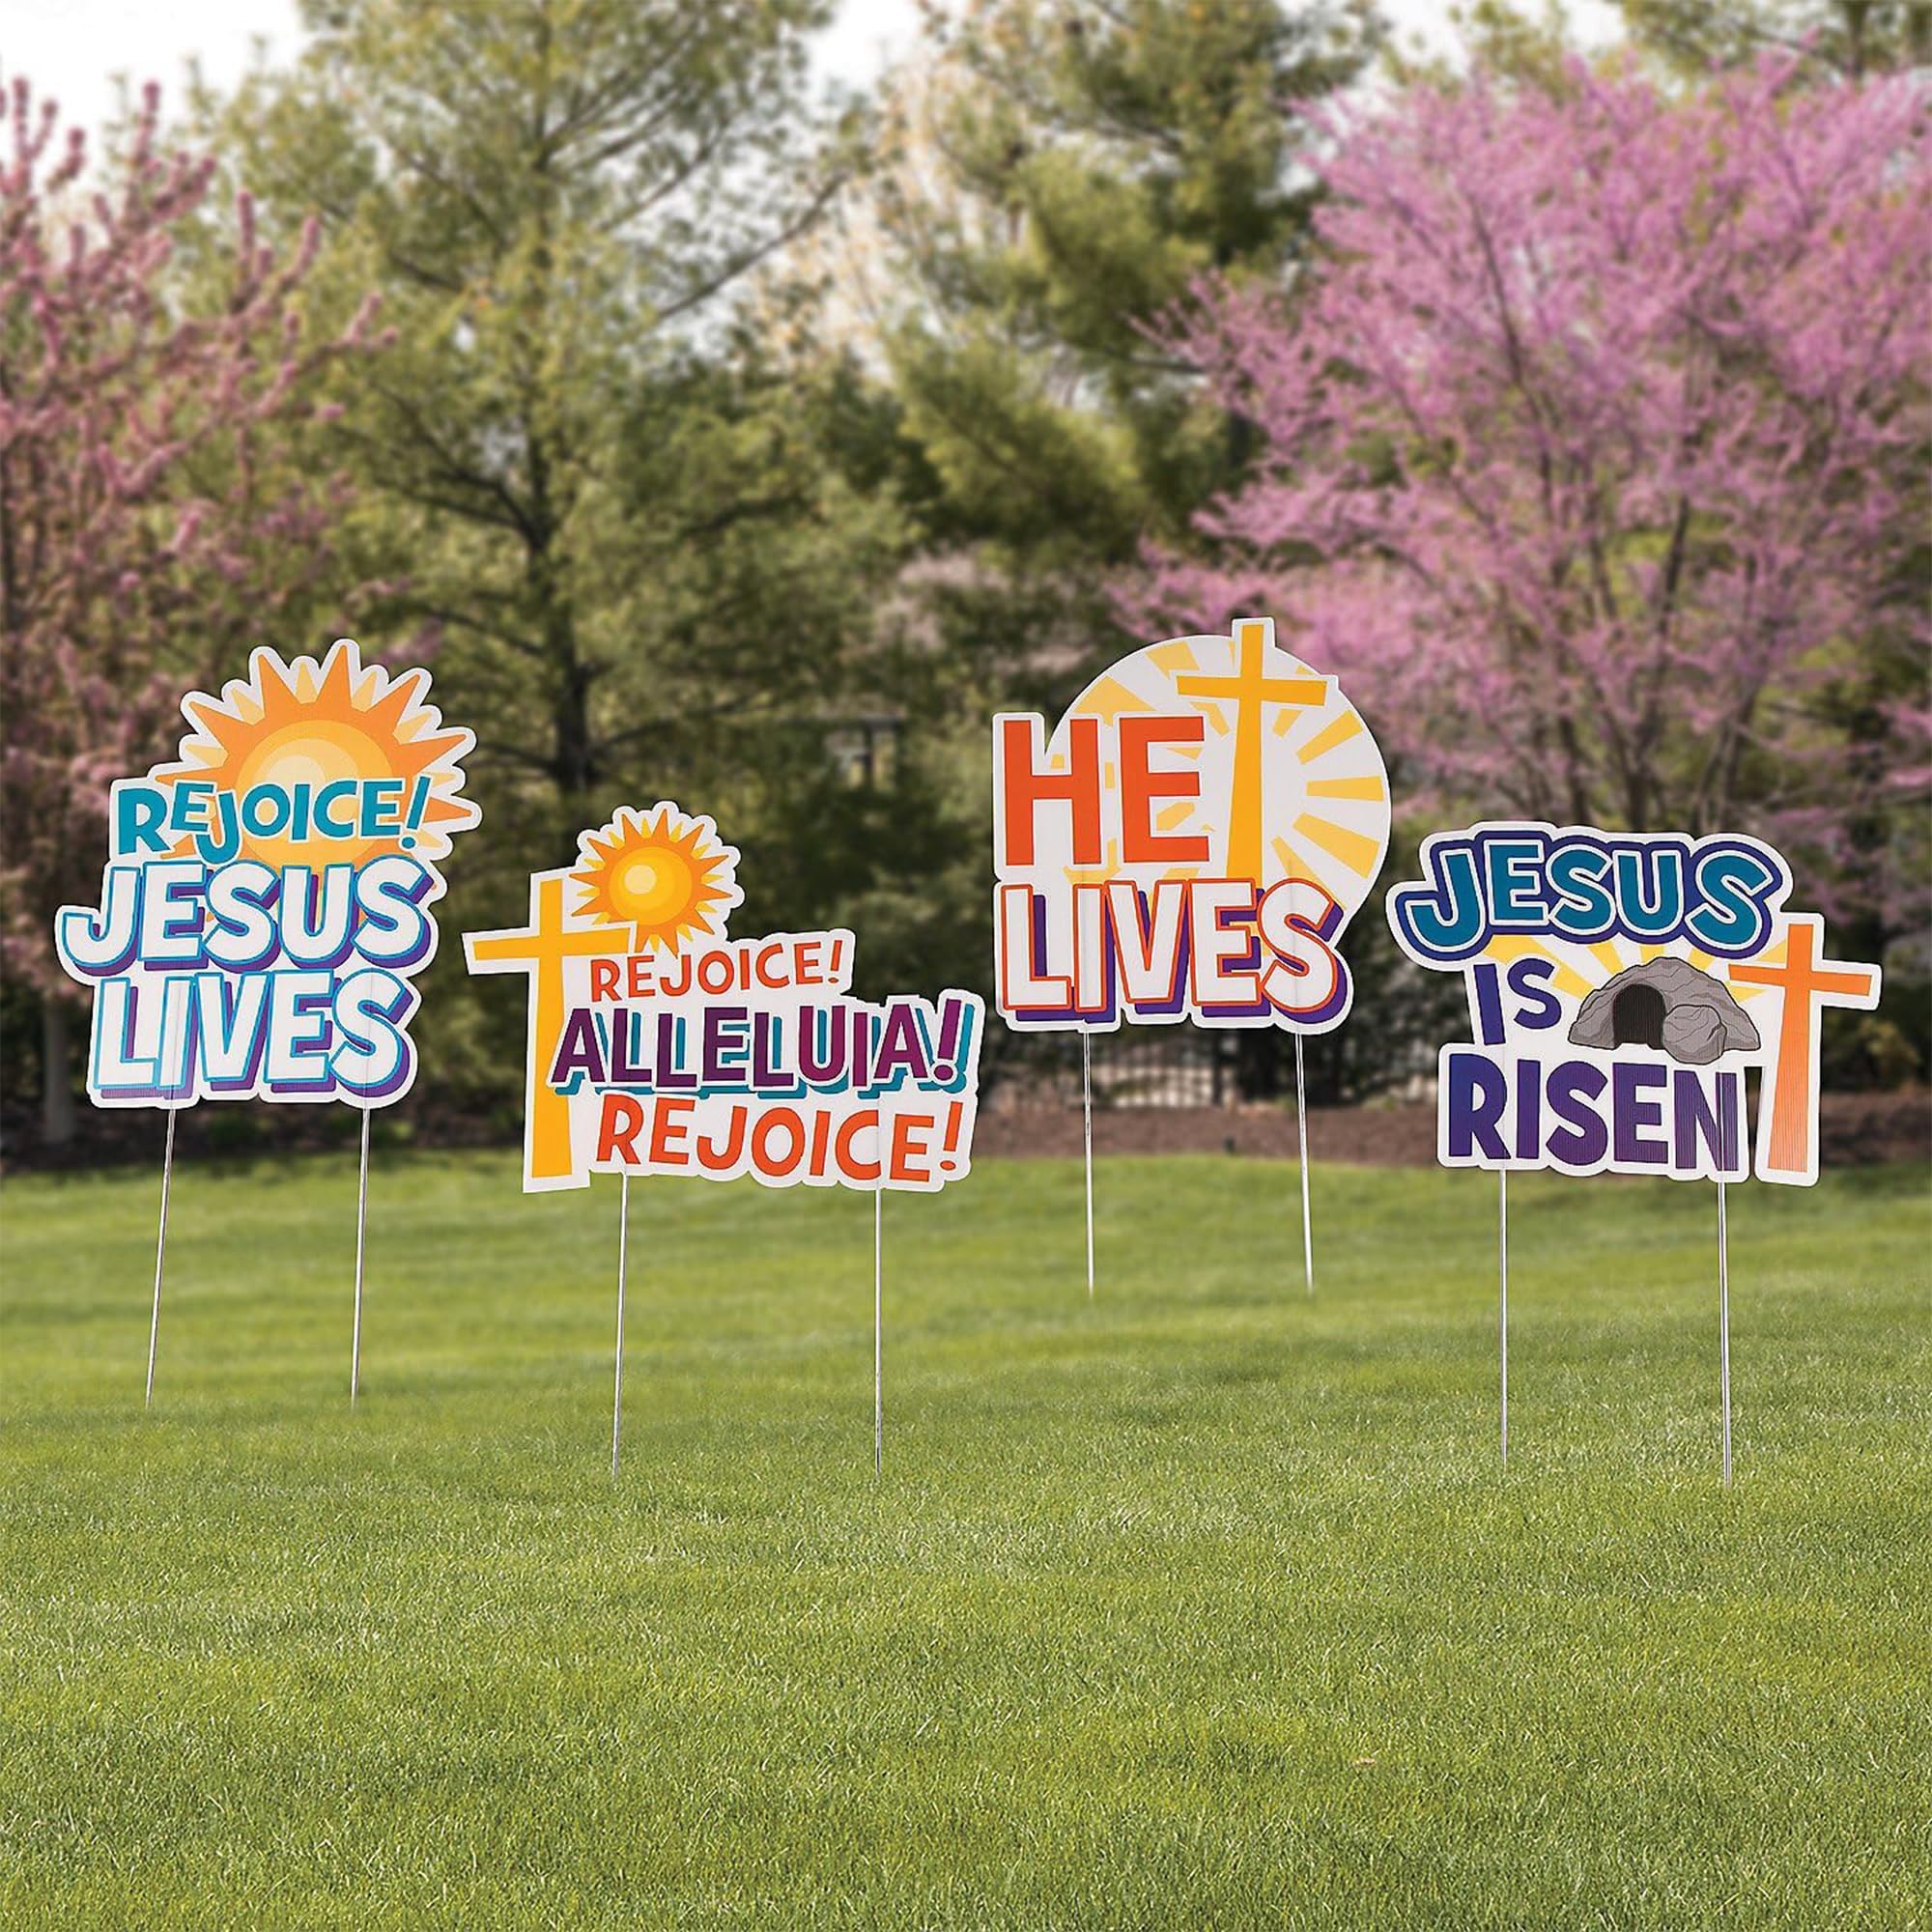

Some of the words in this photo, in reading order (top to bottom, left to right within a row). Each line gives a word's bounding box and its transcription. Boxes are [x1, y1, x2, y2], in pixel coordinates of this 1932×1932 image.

[118, 777, 432, 864] REJOICE!
[1003, 716, 1210, 867] HE
[62, 854, 434, 976] JESUS
[1000, 877, 1346, 1024] LIVES
[1407, 839, 1775, 953] JESUS
[589, 939, 843, 1003] REJOICE!
[1472, 957, 1562, 1045] IS
[93, 968, 414, 1099] LIVES
[552, 997, 975, 1099] ALLELUIA!
[596, 1094, 964, 1183] REJOICE!
[1449, 1053, 1740, 1171] RISEN
